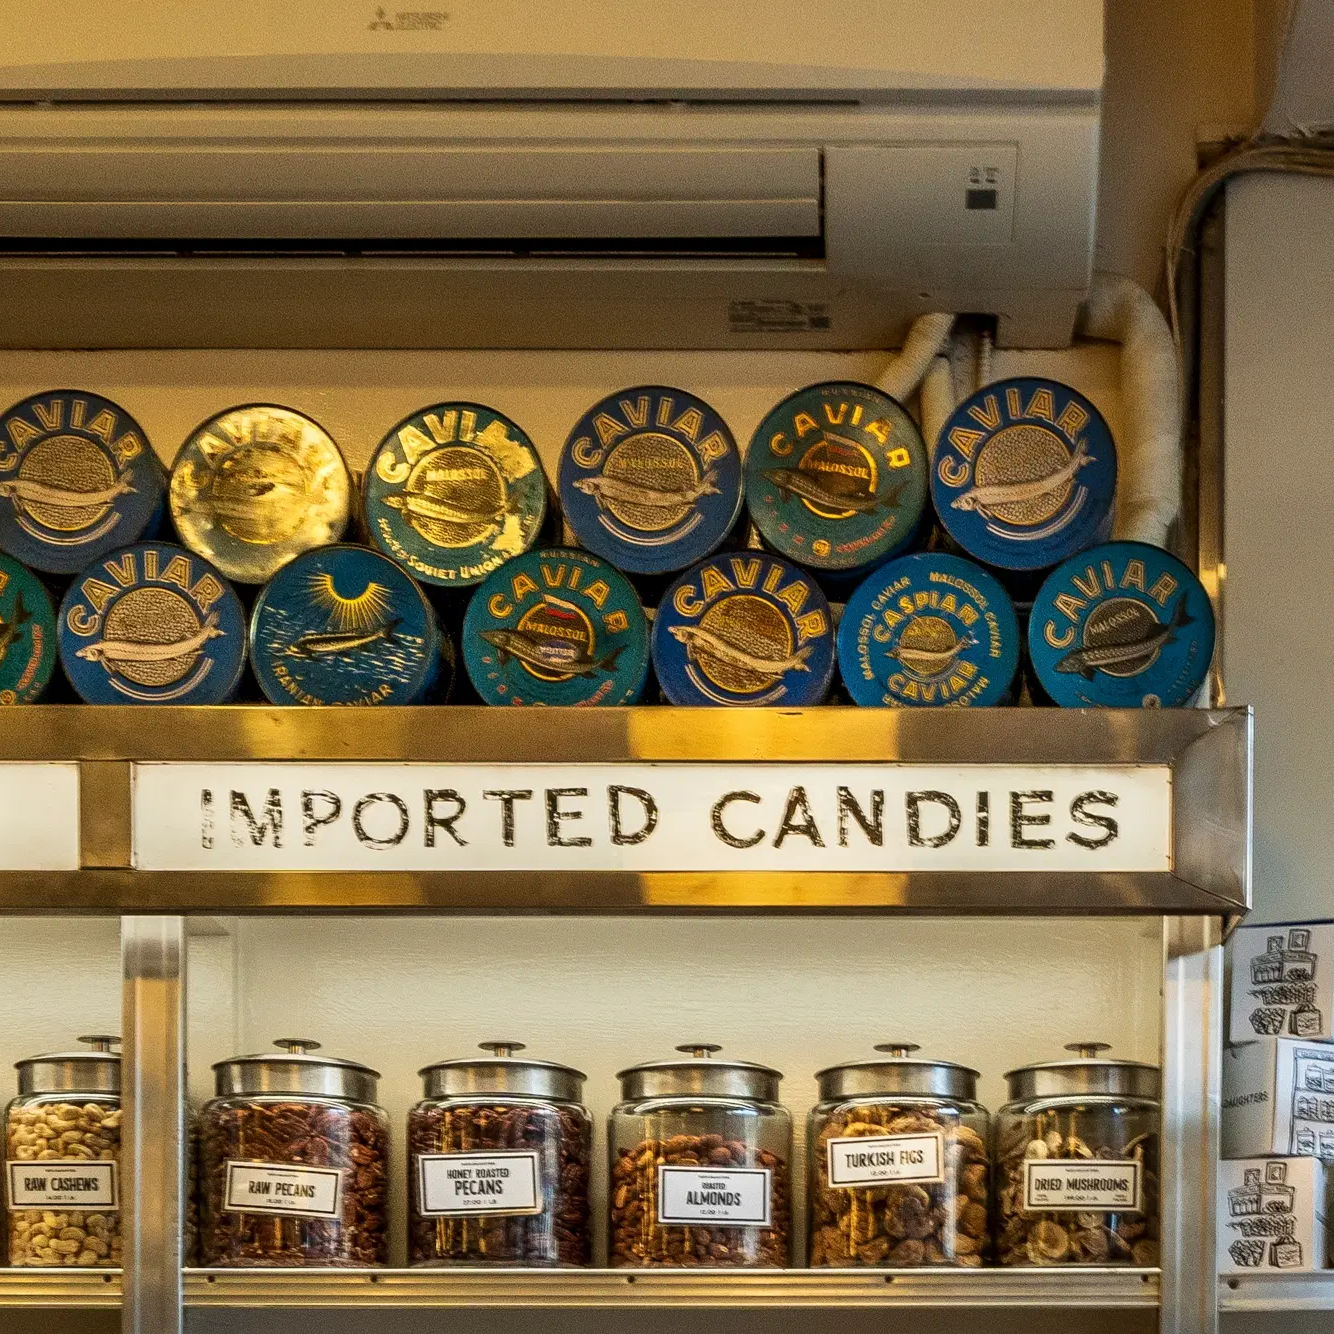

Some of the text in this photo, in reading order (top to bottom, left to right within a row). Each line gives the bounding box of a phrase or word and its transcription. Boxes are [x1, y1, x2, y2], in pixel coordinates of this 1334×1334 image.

[572, 395, 728, 470] CAVIAR
[770, 403, 911, 471] CAVIAR
[938, 387, 1089, 487] CAVIAR
[408, 554, 505, 581] SOVIET UNION
[66, 551, 224, 637] CAVIAR
[487, 562, 629, 634] CAVIAR
[673, 557, 826, 645] CAVIAR
[872, 591, 980, 643] CASPIAN
[1044, 559, 1179, 649] CAVIAR
[887, 660, 979, 701] CAVIAR
[200, 783, 1120, 852] IMPORTED CANDIES
[446, 1168, 509, 1180] HONEY ROASTED
[844, 1149, 925, 1169] TURKISH FIGS
[24, 1177, 98, 1192] RAW CASHEWS
[248, 1180, 315, 1198] RAW PECANS
[454, 1179, 504, 1196] PECANS
[686, 1191, 742, 1206] ALMONDS
[1034, 1178, 1130, 1191] DRIED MUSHROOMS
